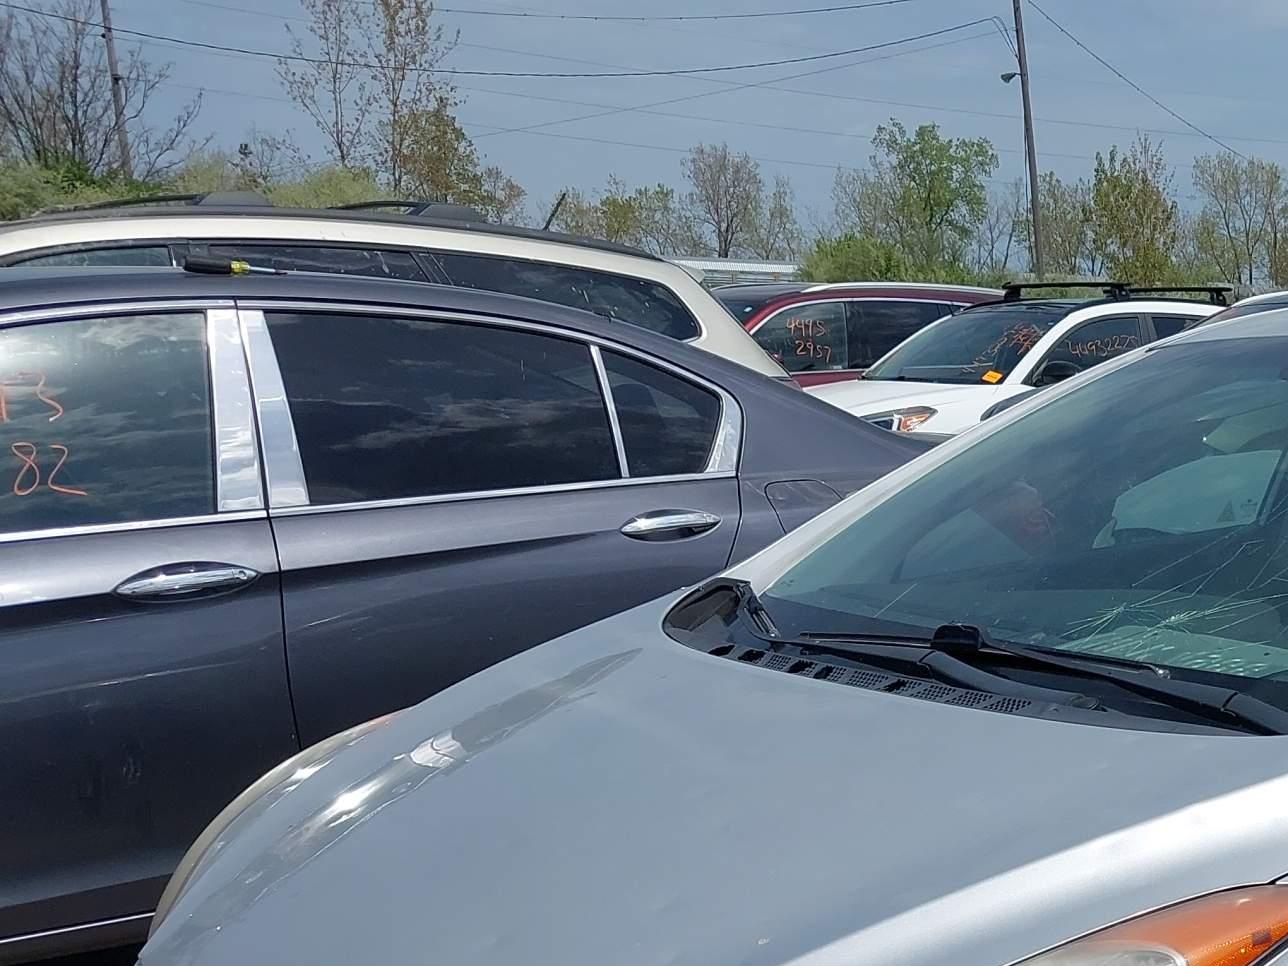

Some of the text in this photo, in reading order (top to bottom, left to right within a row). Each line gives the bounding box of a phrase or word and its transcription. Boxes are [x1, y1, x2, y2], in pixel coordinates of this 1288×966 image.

[786, 317, 825, 337] 4495
[795, 339, 832, 363] 2957
[11, 441, 88, 496] 82
